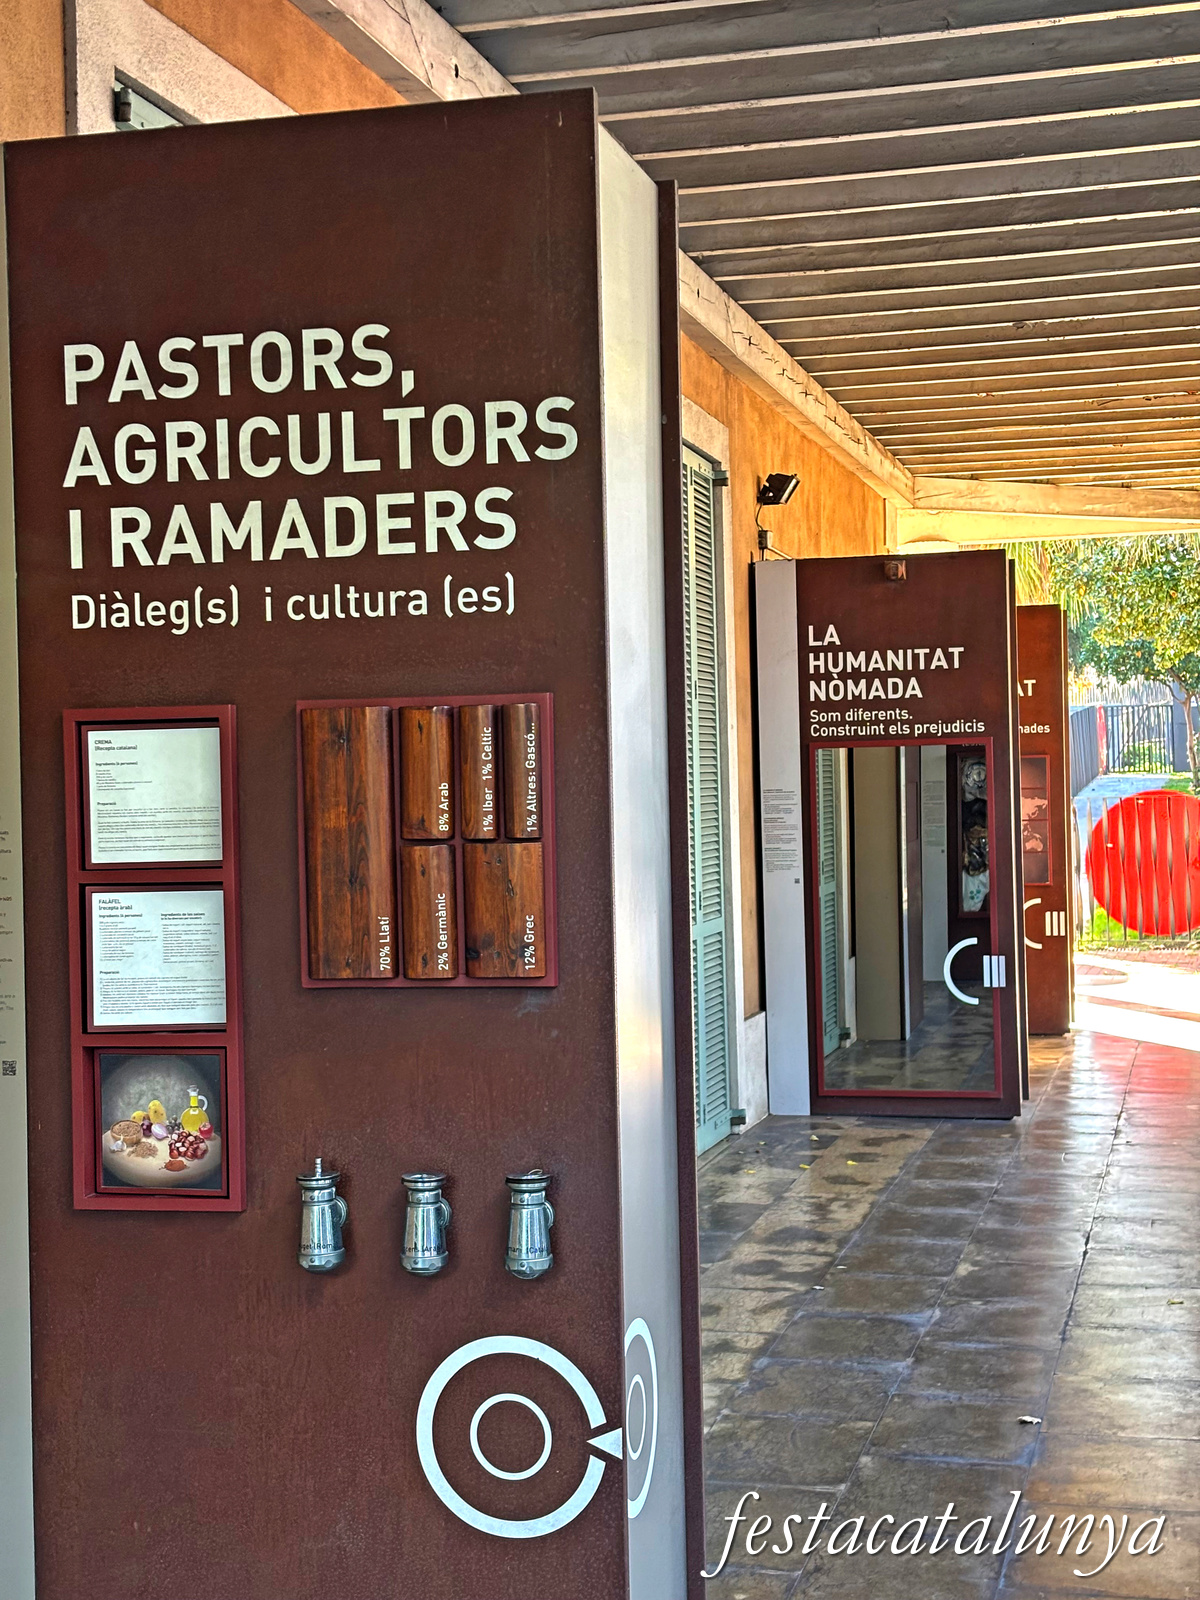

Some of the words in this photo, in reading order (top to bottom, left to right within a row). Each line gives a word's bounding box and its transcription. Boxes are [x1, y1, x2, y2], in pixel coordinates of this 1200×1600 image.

[63, 323, 415, 405] PASTORS,
[62, 396, 578, 488] AGRICULTORS
[68, 509, 84, 570] I
[110, 486, 517, 568] RAMADERS
[71, 584, 239, 635] Diàleg(s)
[264, 586, 272, 622] i
[286, 583, 428, 621] cultura
[443, 571, 515, 618] (es)
[808, 624, 841, 647] LA
[808, 646, 965, 674] HUMANITAT
[809, 673, 923, 702] NÒMADA
[810, 709, 841, 723] Som
[845, 707, 914, 722] diferents.
[810, 724, 885, 737] Construint
[888, 721, 911, 735] els
[914, 719, 986, 737] prejudicis
[480, 726, 492, 760] Celtic
[481, 763, 493, 781] 1%
[438, 782, 449, 811] Arab
[482, 787, 493, 811] Iber
[526, 771, 537, 812] Altres:
[438, 813, 449, 831] 8%
[482, 814, 494, 832] 1%
[526, 814, 538, 832] 1%
[378, 915, 390, 943] Llatí
[435, 892, 448, 950] Germànic
[523, 914, 535, 943] Grec
[379, 945, 391, 971] 70%
[437, 952, 449, 971] 2%
[524, 945, 536, 970] 12%
